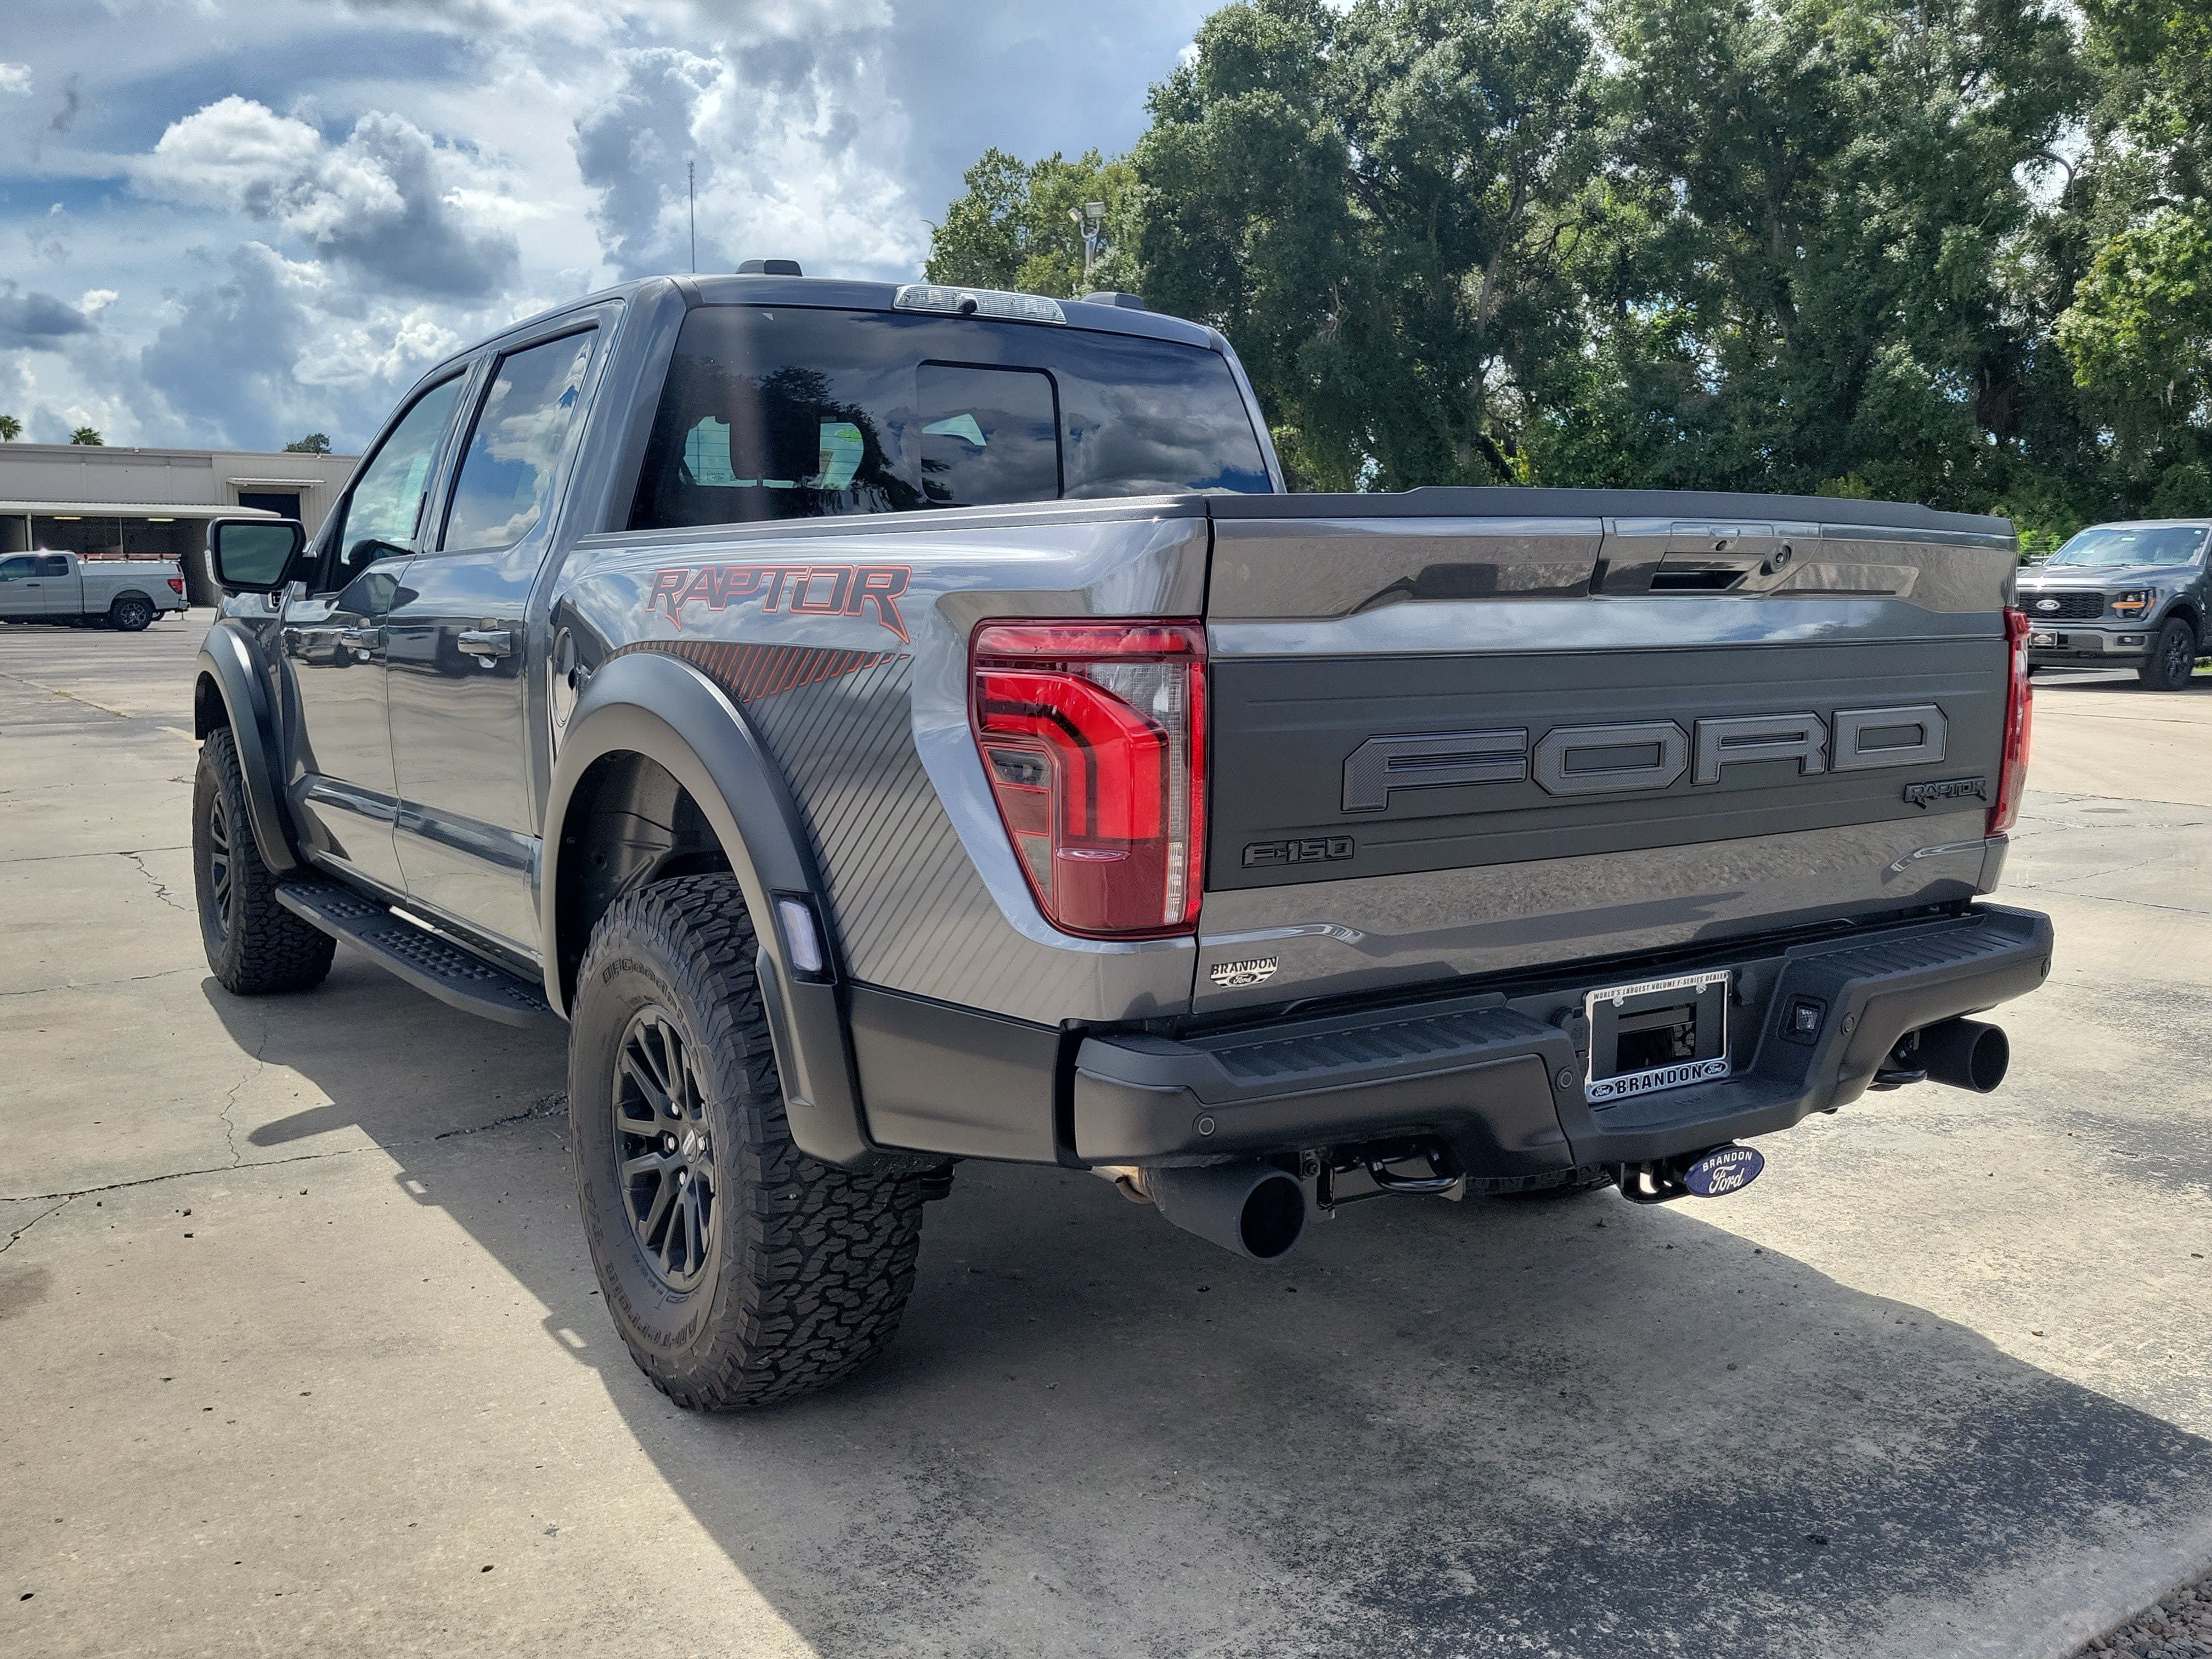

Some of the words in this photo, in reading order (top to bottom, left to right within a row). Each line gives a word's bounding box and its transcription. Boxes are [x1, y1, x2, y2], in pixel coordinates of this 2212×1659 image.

[645, 565, 912, 644] RAPTOR
[1340, 703, 1949, 813] FORD
[1903, 776, 1987, 809] RAPTOR
[1242, 836, 1355, 867] F-150
[1211, 957, 1277, 975] BRANDON
[1233, 973, 1253, 984] Ford
[1593, 989, 1621, 1000] WORLD'S
[1623, 984, 1650, 995] LARGEST
[1652, 980, 1675, 990] VOLUME
[1677, 975, 1703, 986] F-SERIES
[1705, 972, 1727, 981] DEALER
[1616, 1064, 1702, 1094] BRANDON
[1707, 1064, 1723, 1074] Ford
[1595, 1086, 1611, 1096] Ford
[1702, 1151, 1752, 1172] BRANDON
[1708, 1164, 1745, 1194] Ford
